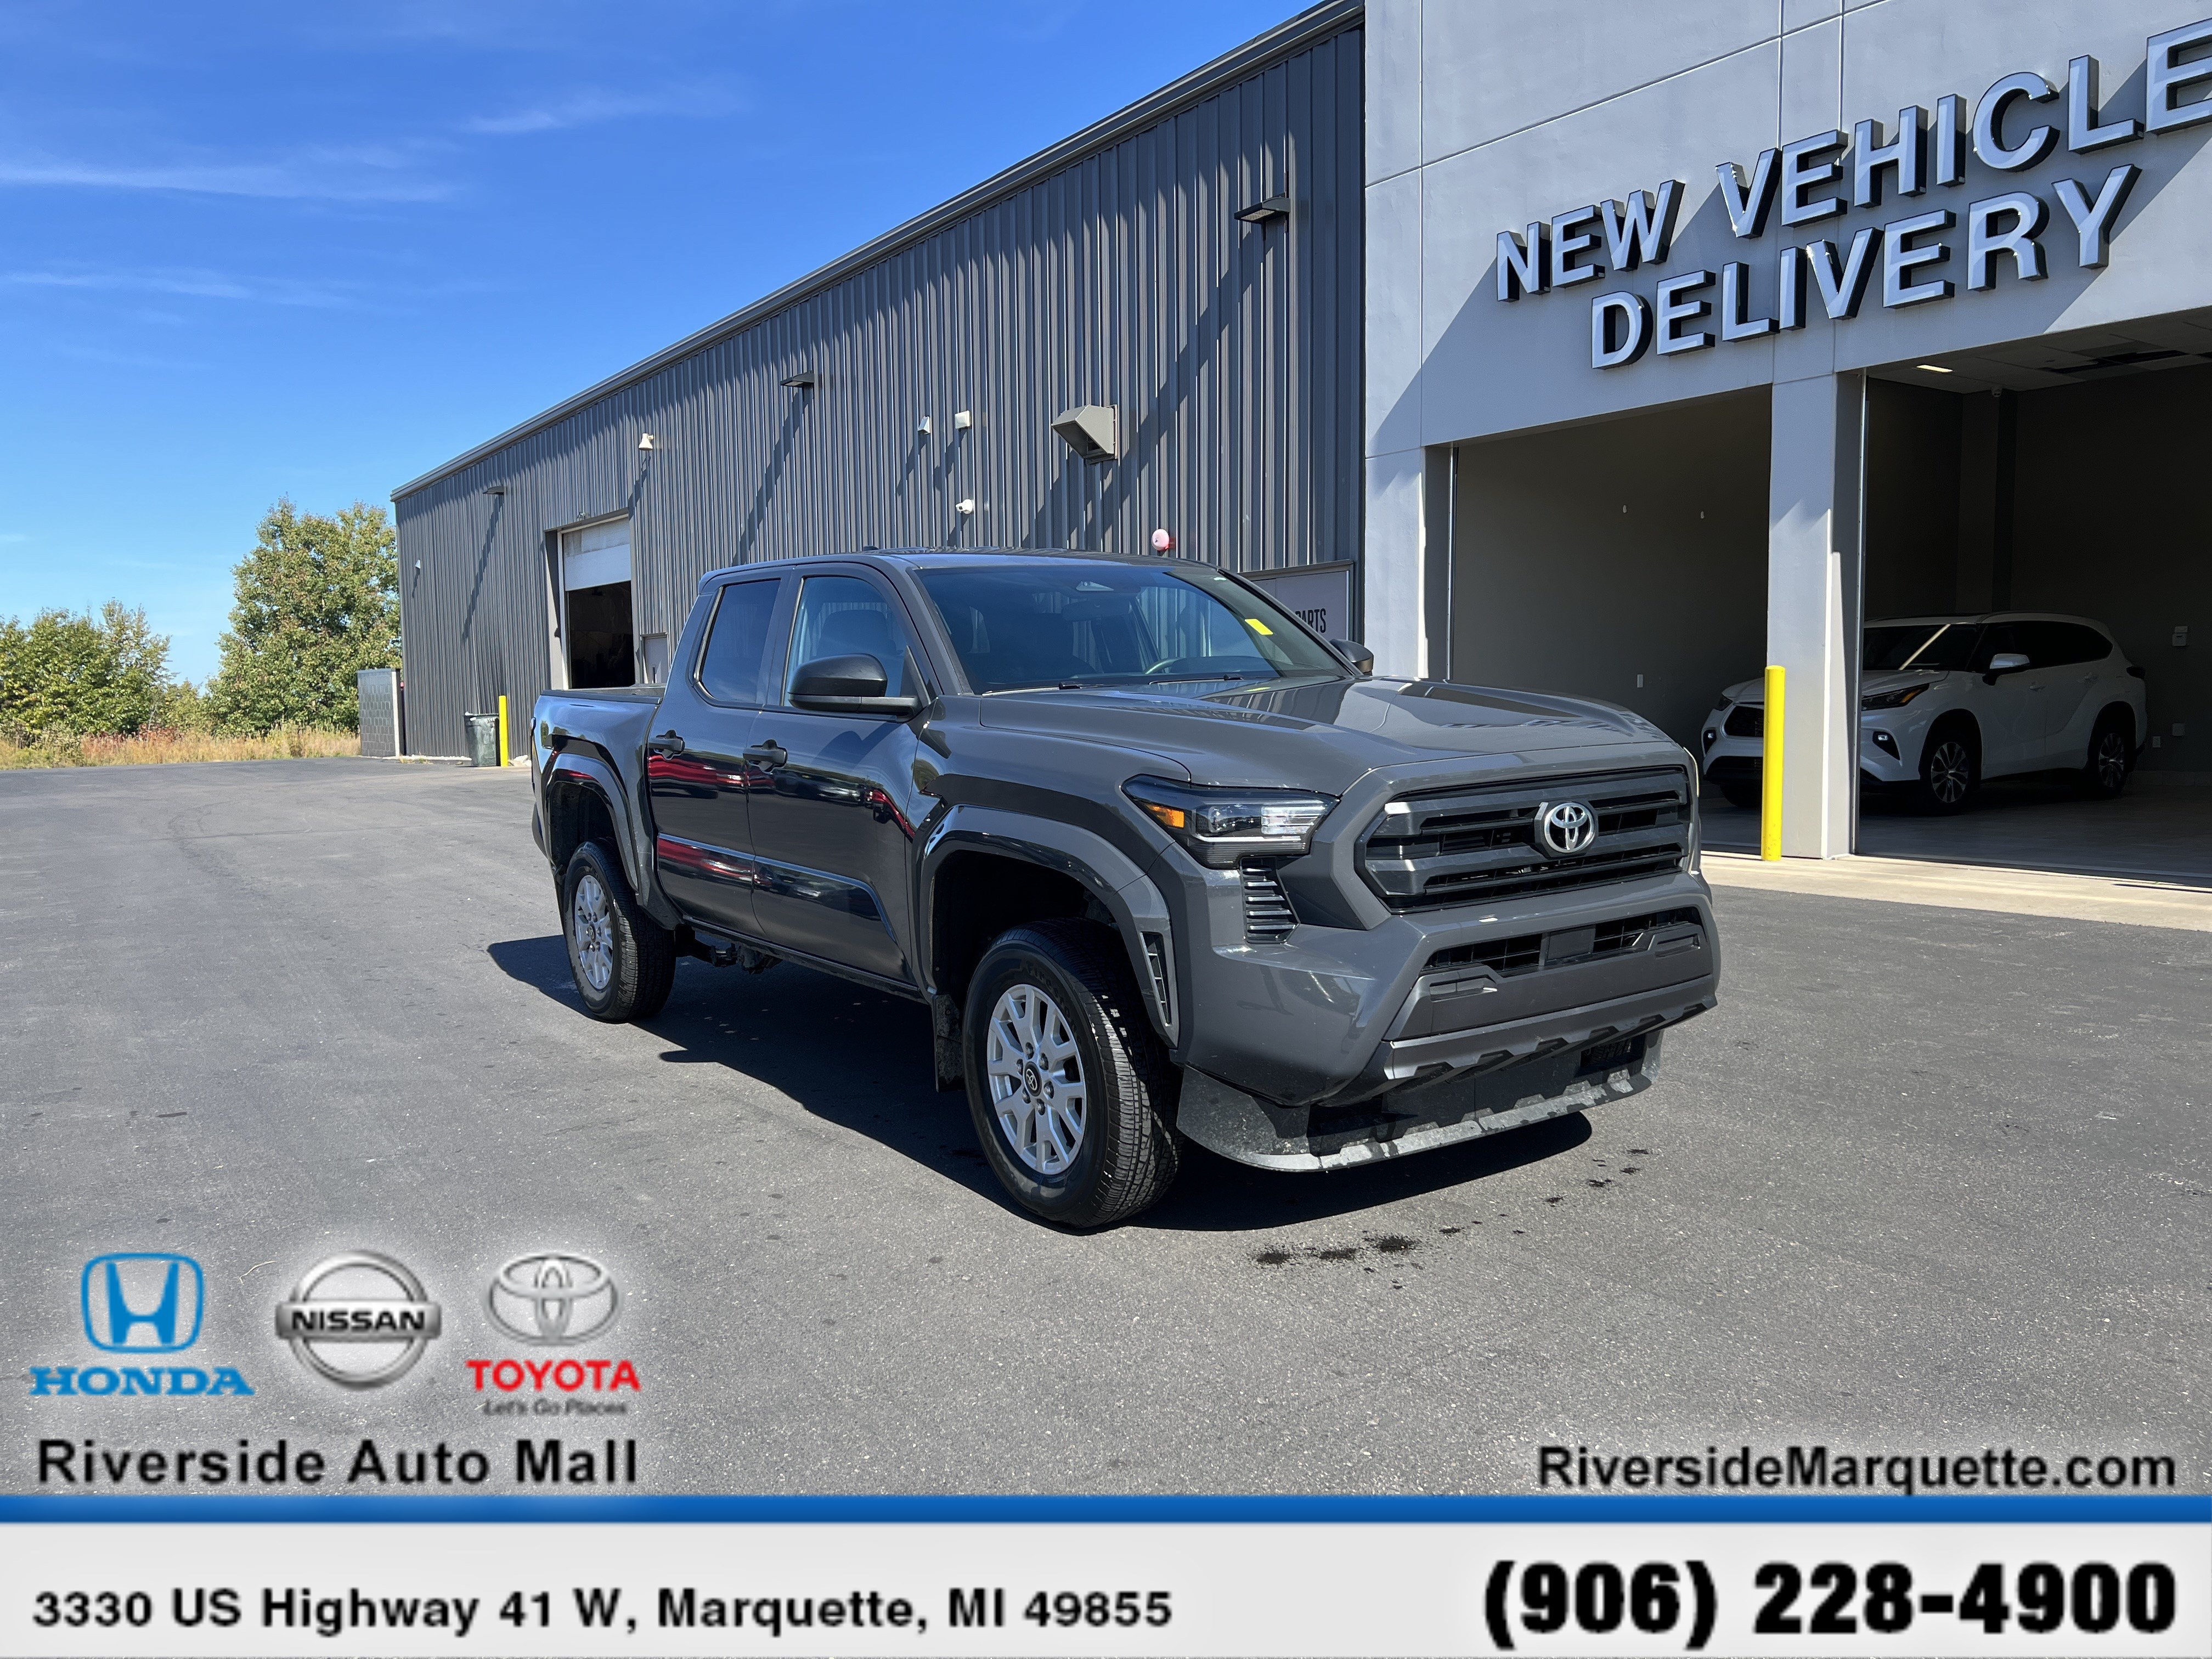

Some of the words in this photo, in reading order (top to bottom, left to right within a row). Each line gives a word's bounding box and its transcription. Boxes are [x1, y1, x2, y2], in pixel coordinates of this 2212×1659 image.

[1496, 179, 1685, 303] NEW
[1716, 18, 2212, 239] VEHICLE
[1592, 164, 2142, 370] DELIVERY
[1295, 608, 1326, 633] RTS
